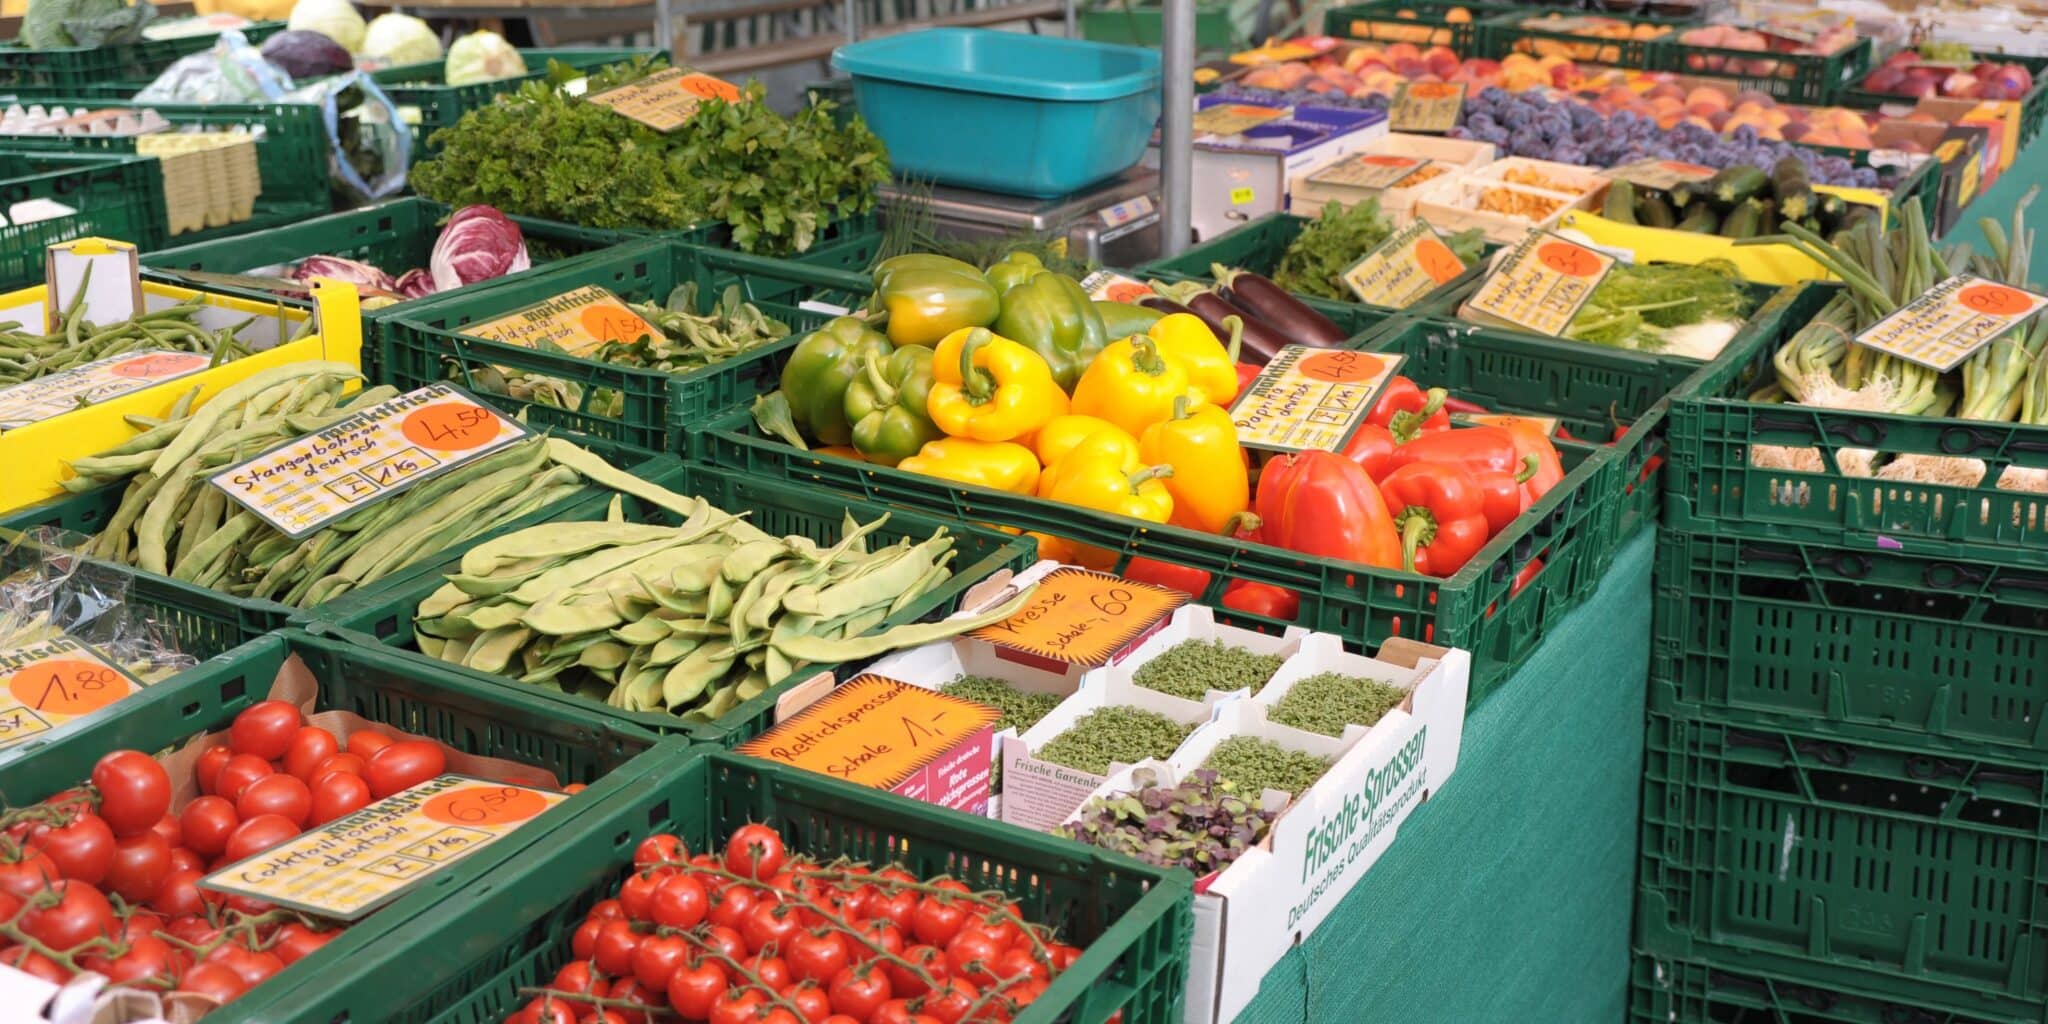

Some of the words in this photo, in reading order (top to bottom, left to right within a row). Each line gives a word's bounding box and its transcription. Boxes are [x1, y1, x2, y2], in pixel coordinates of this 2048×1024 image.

[521, 286, 609, 323] marktfrisch
[317, 384, 452, 442] marktfrisch
[420, 406, 490, 442] 4,50
[303, 437, 377, 478] deutsch
[994, 591, 1067, 634] Kresse
[826, 742, 894, 779] Schale
[1014, 758, 1052, 778] Frische
[324, 775, 465, 836] marktfrisch
[1303, 792, 1360, 885] Frische
[1361, 723, 1428, 824] Sprossen
[1287, 856, 1346, 931] Deutsches
[1347, 766, 1428, 865] Qualitätsprodukt
